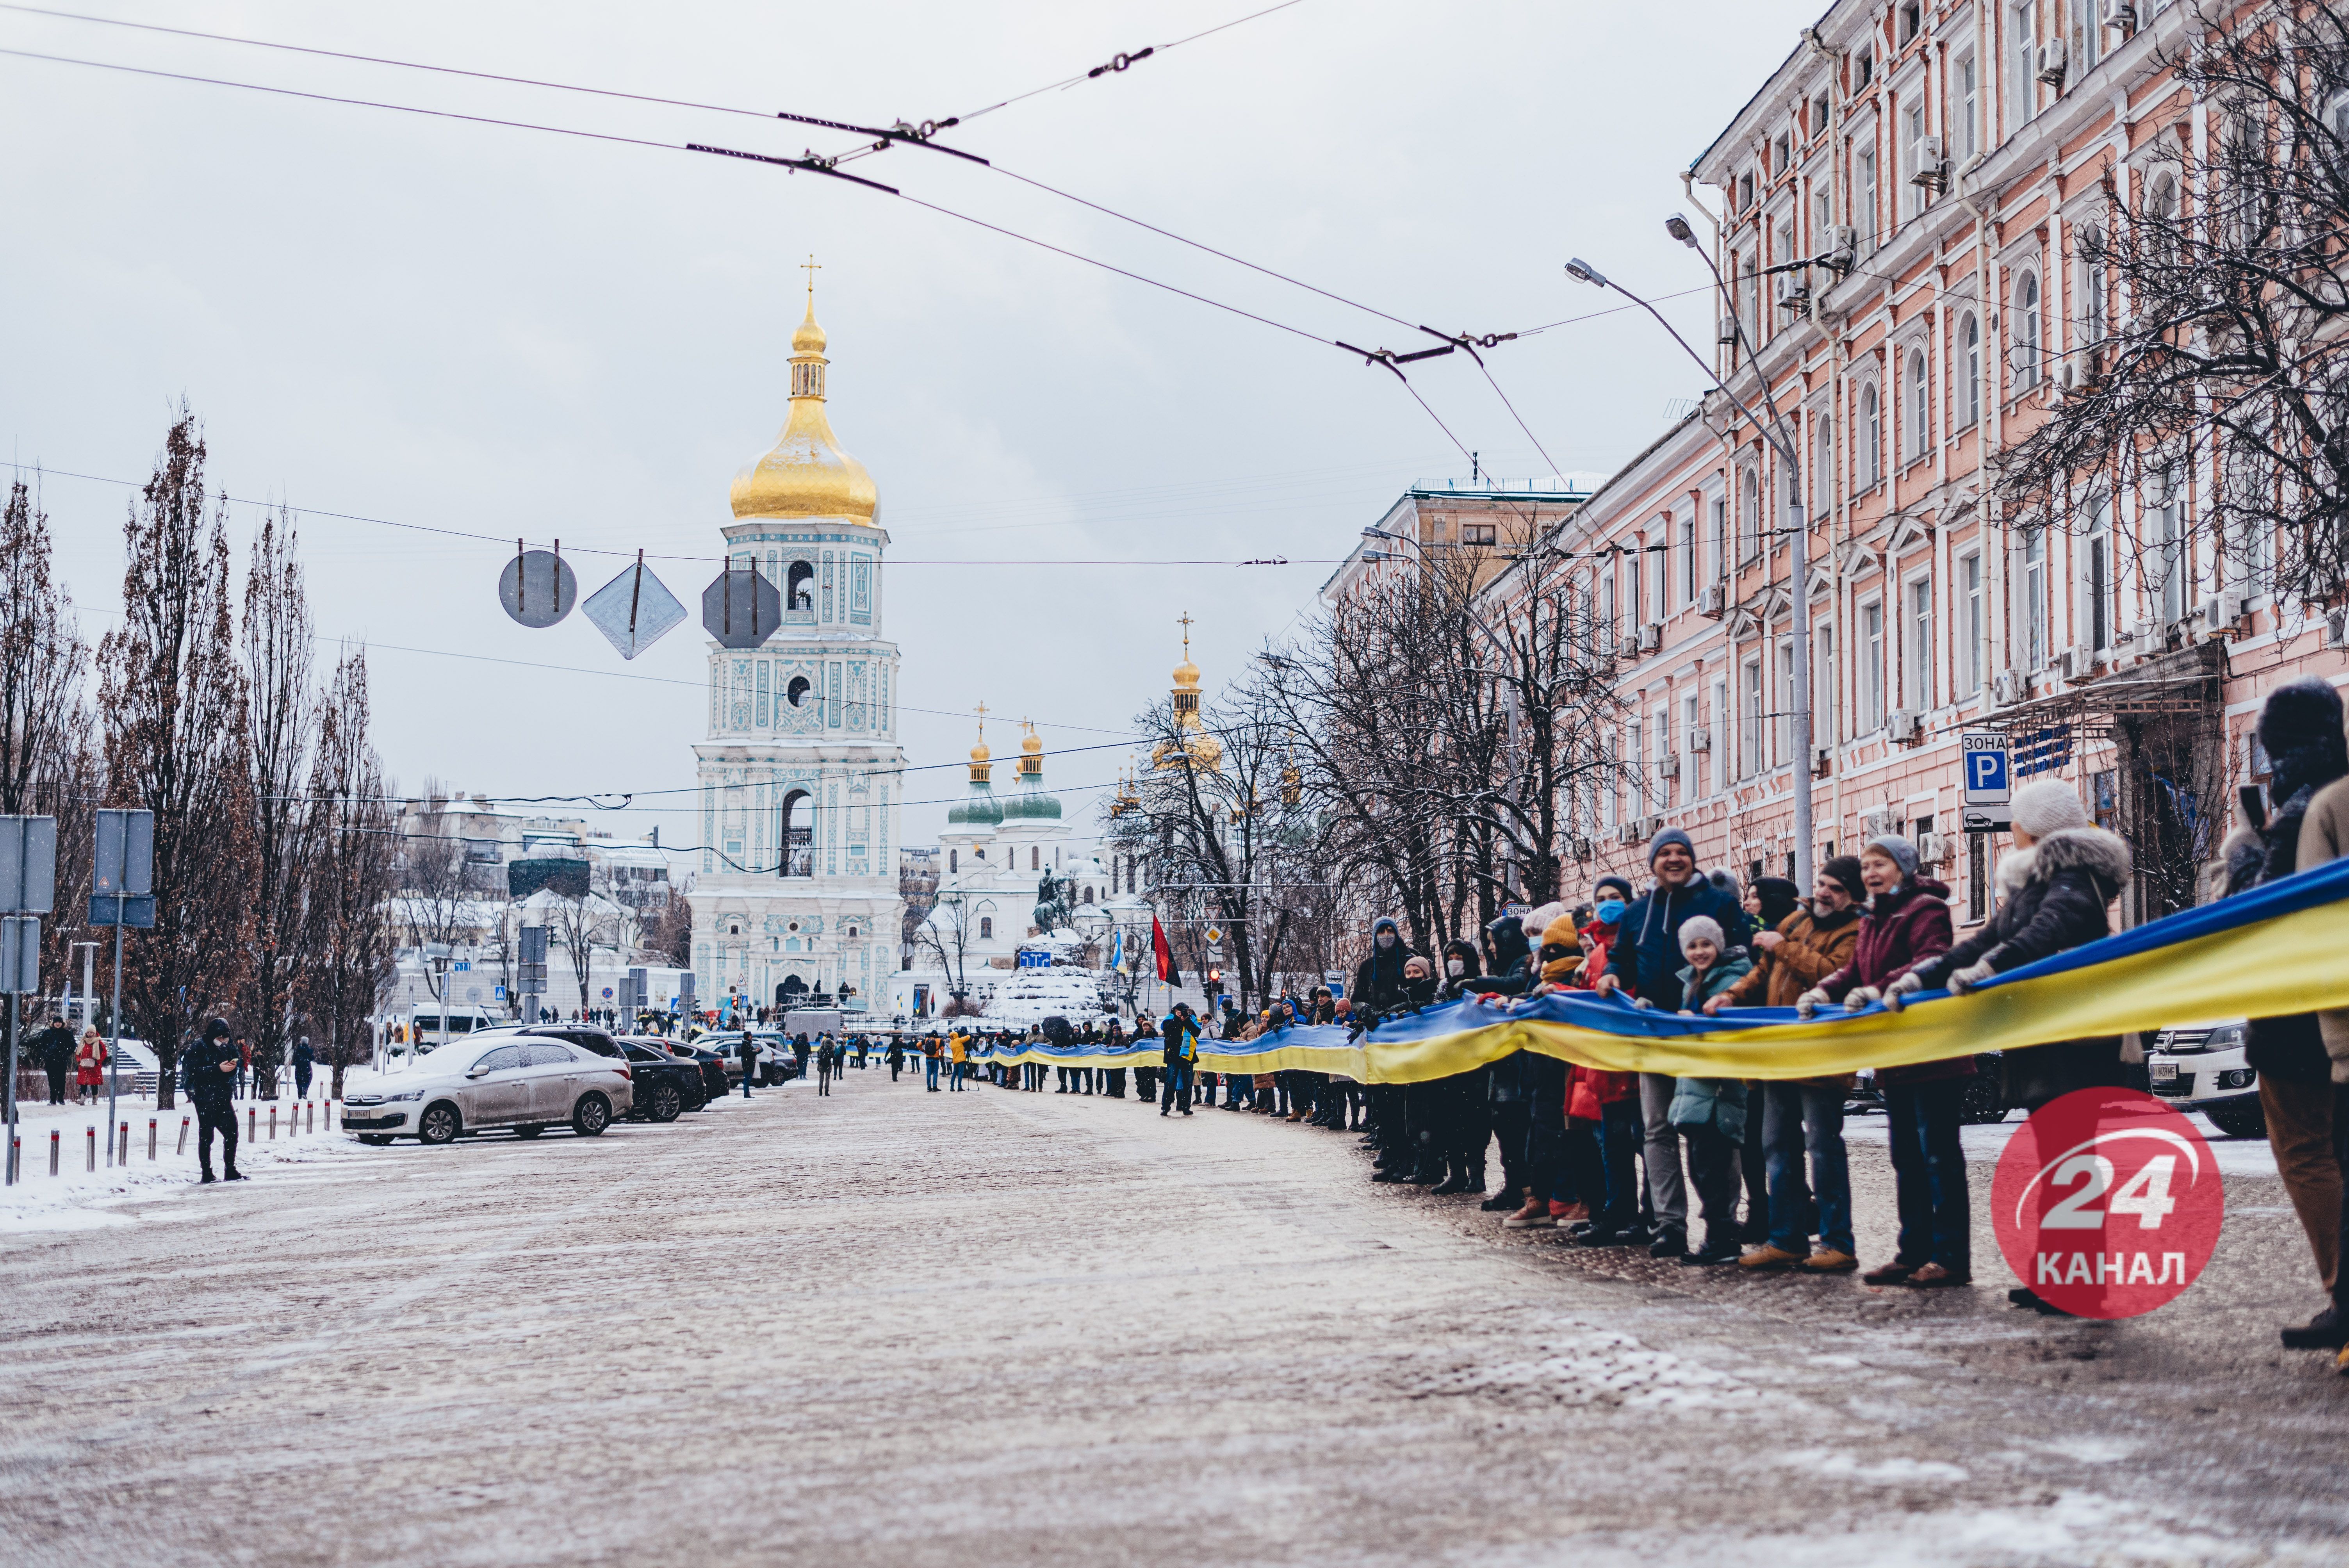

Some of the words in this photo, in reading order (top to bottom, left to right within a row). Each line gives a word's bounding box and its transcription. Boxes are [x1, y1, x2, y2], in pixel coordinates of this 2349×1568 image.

[1964, 737, 2006, 750] ЗОНА
[1976, 755, 1997, 787] P
[2021, 759, 2046, 777] КИВЬКІЙ
[2046, 755, 2068, 770] ОЛАСІ
